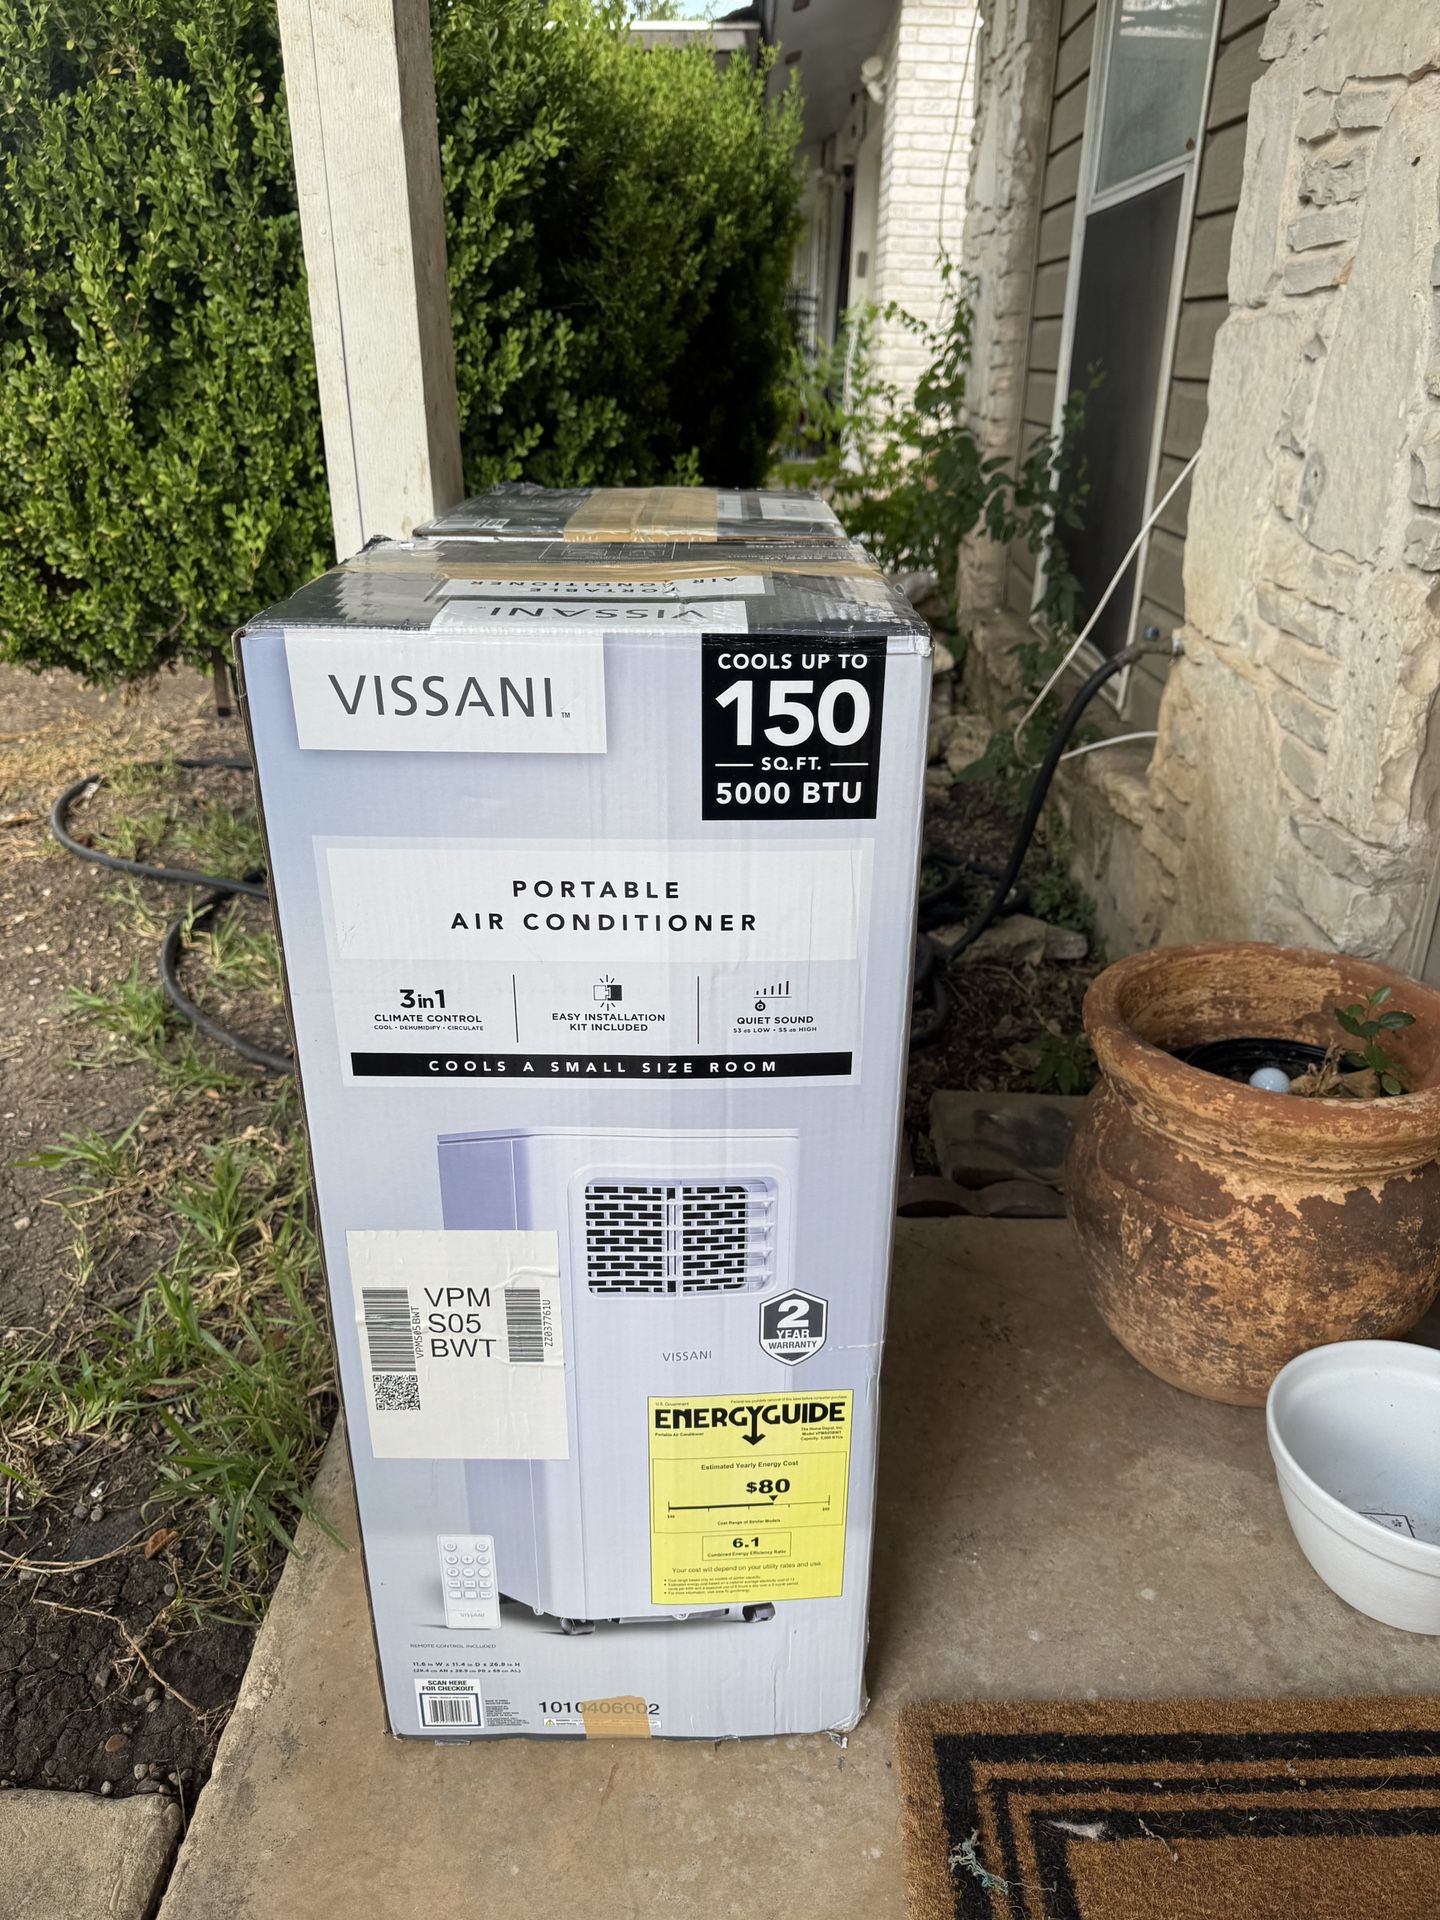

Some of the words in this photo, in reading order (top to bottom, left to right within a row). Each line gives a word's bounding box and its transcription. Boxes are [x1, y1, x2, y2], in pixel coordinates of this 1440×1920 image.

[490, 607, 707, 621] VISSANI
[717, 653, 793, 670] COOLS
[801, 653, 831, 669] UP
[838, 653, 868, 669] TO
[328, 674, 553, 718] VISSANI
[715, 678, 871, 747] 150
[761, 756, 822, 771] SQ.FT.
[716, 782, 791, 805] 5000
[802, 781, 862, 804] BTU
[513, 880, 679, 899] PORTABLE
[451, 912, 504, 930] AIR
[523, 913, 756, 932] CONDITIONER
[374, 1014, 424, 1022] CLIMATE
[427, 1014, 482, 1023] CONTROL
[552, 1013, 581, 1021] EASY
[584, 1013, 665, 1021] INSTALLATION
[737, 1016, 771, 1024] QUIET
[774, 1016, 814, 1024] SOUND
[570, 1023, 587, 1031] KIT
[591, 1023, 648, 1031] INCLUDED
[429, 1060, 506, 1072] COOLS
[523, 1060, 534, 1072] A
[551, 1061, 626, 1073] SMALL
[642, 1062, 693, 1074] SIZE
[710, 1061, 777, 1073] ROOM
[424, 1287, 491, 1307] VPM
[777, 1299, 810, 1329] 2
[428, 1313, 482, 1334] S05
[776, 1329, 810, 1339] YEAR
[430, 1338, 497, 1358] BWT
[768, 1340, 818, 1350] WARRANTY
[662, 1350, 712, 1362] VISSANI
[655, 1402, 846, 1429] ENERGYGUIDE
[701, 1463, 734, 1471] Estimated
[735, 1462, 757, 1470] Yearly
[758, 1461, 781, 1469] Energy
[746, 1478, 791, 1494] $80
[732, 1537, 760, 1548] 6.1
[714, 1565, 738, 1573] depend
[762, 1563, 779, 1571] utility
[539, 1701, 660, 1715] 1010406002
